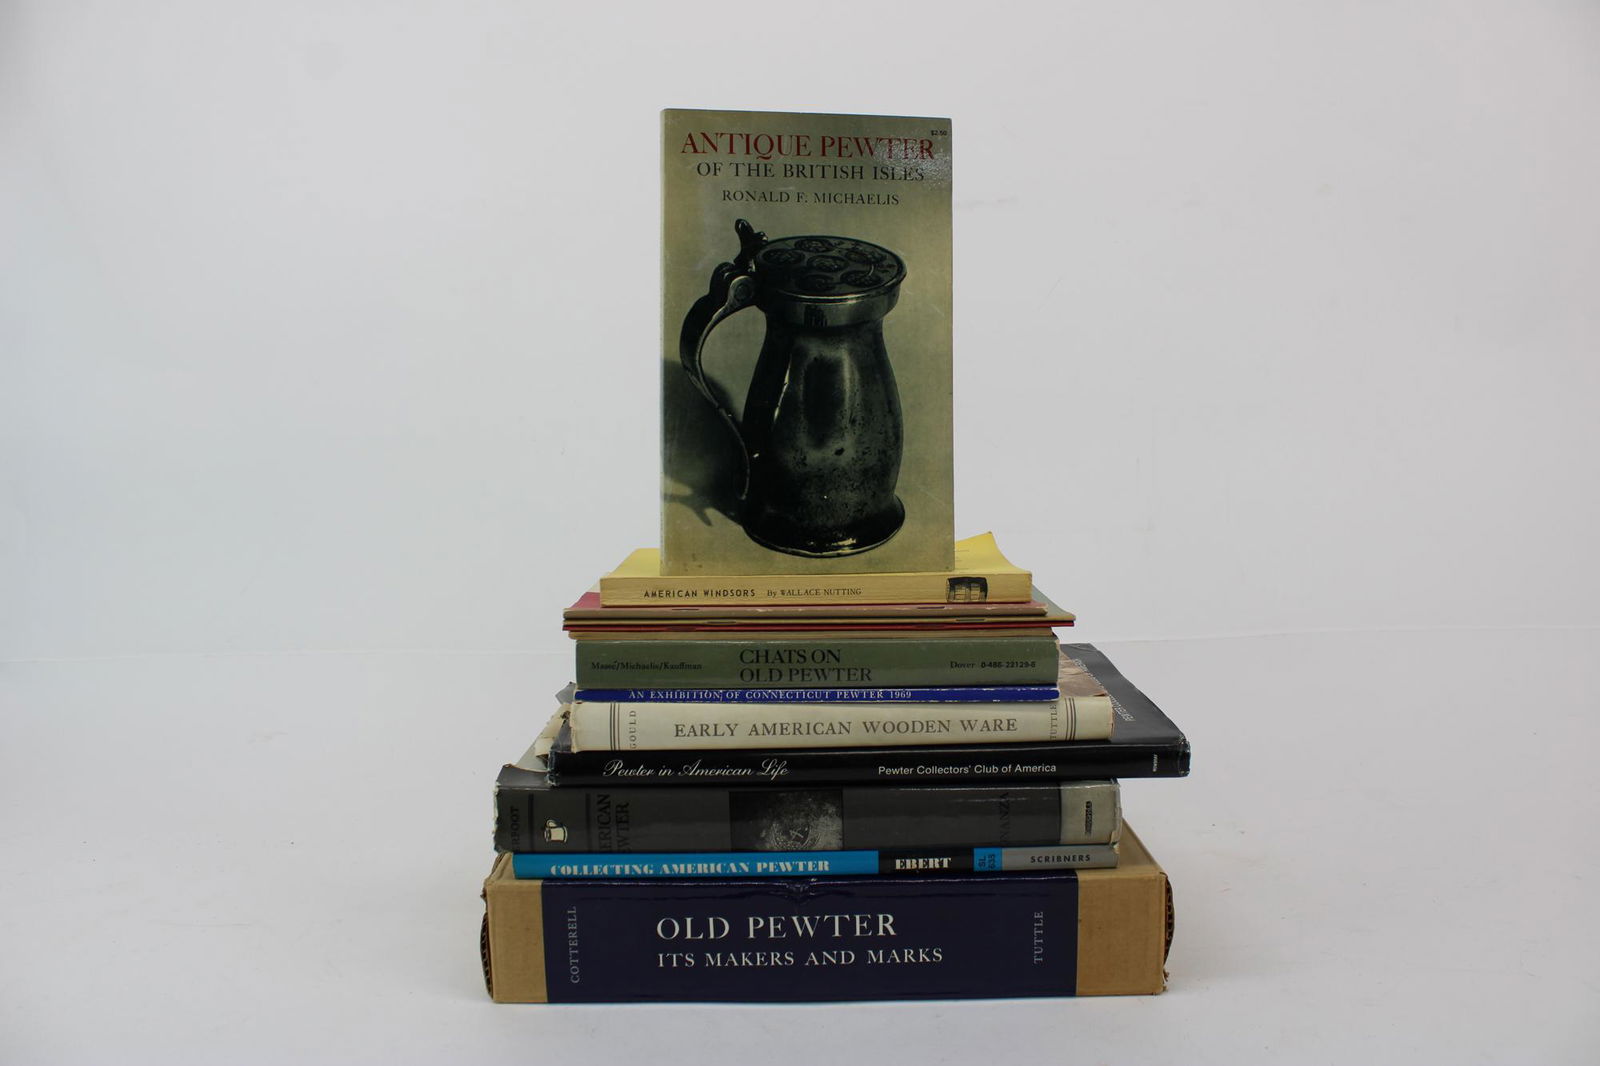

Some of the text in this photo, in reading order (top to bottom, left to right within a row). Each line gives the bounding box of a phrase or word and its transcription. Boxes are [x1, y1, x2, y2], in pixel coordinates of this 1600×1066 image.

[681, 132, 936, 160] ANTIQUE PEWTER
[697, 162, 925, 182] OF THE BRITISH ISLES
[722, 190, 900, 206] RONALD F. MICHAELIS
[643, 588, 862, 598] AMERICAN WINDSORS By WALLACE NUTTING
[739, 649, 841, 665] CHATS ON
[950, 661, 976, 669] Dover
[739, 667, 873, 683] OLD PEWTER
[628, 690, 912, 700] AN EXHIBITION OF CONNECTICUT PEWTER 1969
[629, 709, 637, 750] GOULD
[673, 718, 1018, 738] EARLY AMERICAN WOODEN WARE
[1050, 703, 1058, 740] TUTTLE
[603, 758, 790, 781] Pewter in American Life
[878, 763, 1057, 775] Pewter Collectors' Club of America
[597, 794, 612, 851] ERICAN
[550, 860, 830, 876] COLLECTING AMERICAN PEWTER
[896, 857, 952, 870] EBERT
[1030, 854, 1091, 864] SCRIBNERS
[656, 914, 897, 940] OLD PEWTER
[567, 906, 580, 984] COTTERELL
[1033, 911, 1044, 964] TUTTLE
[658, 948, 943, 968] ITS MAKERS AND MARKS
